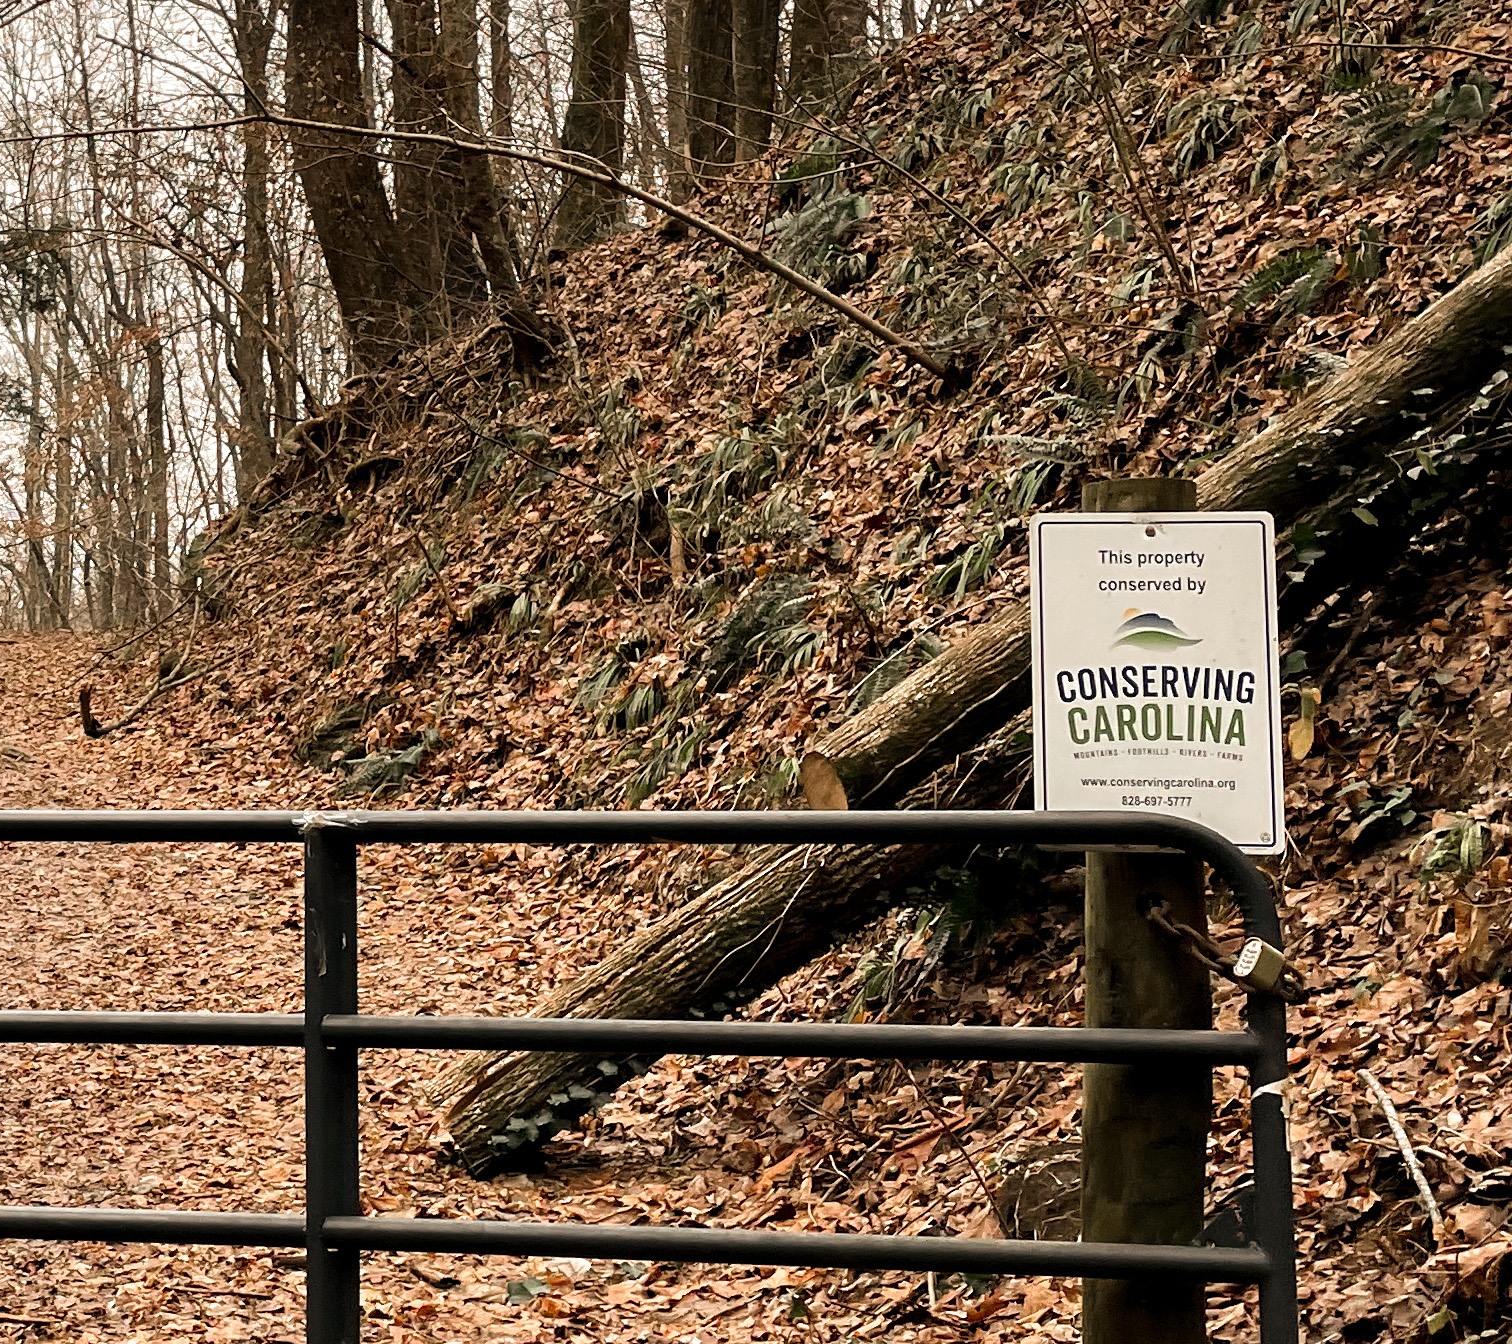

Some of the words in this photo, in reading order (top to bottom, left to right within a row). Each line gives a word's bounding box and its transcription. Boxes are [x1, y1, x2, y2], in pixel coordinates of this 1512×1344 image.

[1098, 549, 1133, 564] This
[1137, 551, 1205, 567] property
[1098, 577, 1182, 591] conserved
[1187, 577, 1207, 594] by
[1056, 665, 1256, 704] CONSERVING
[1067, 703, 1246, 746] CAROLINA
[1073, 748, 1118, 759] MOUNTAINS
[1216, 751, 1244, 761] FARMS
[1080, 777, 1236, 790] www.conservingcarolina.org
[1121, 795, 1193, 807] 828-697-5777
